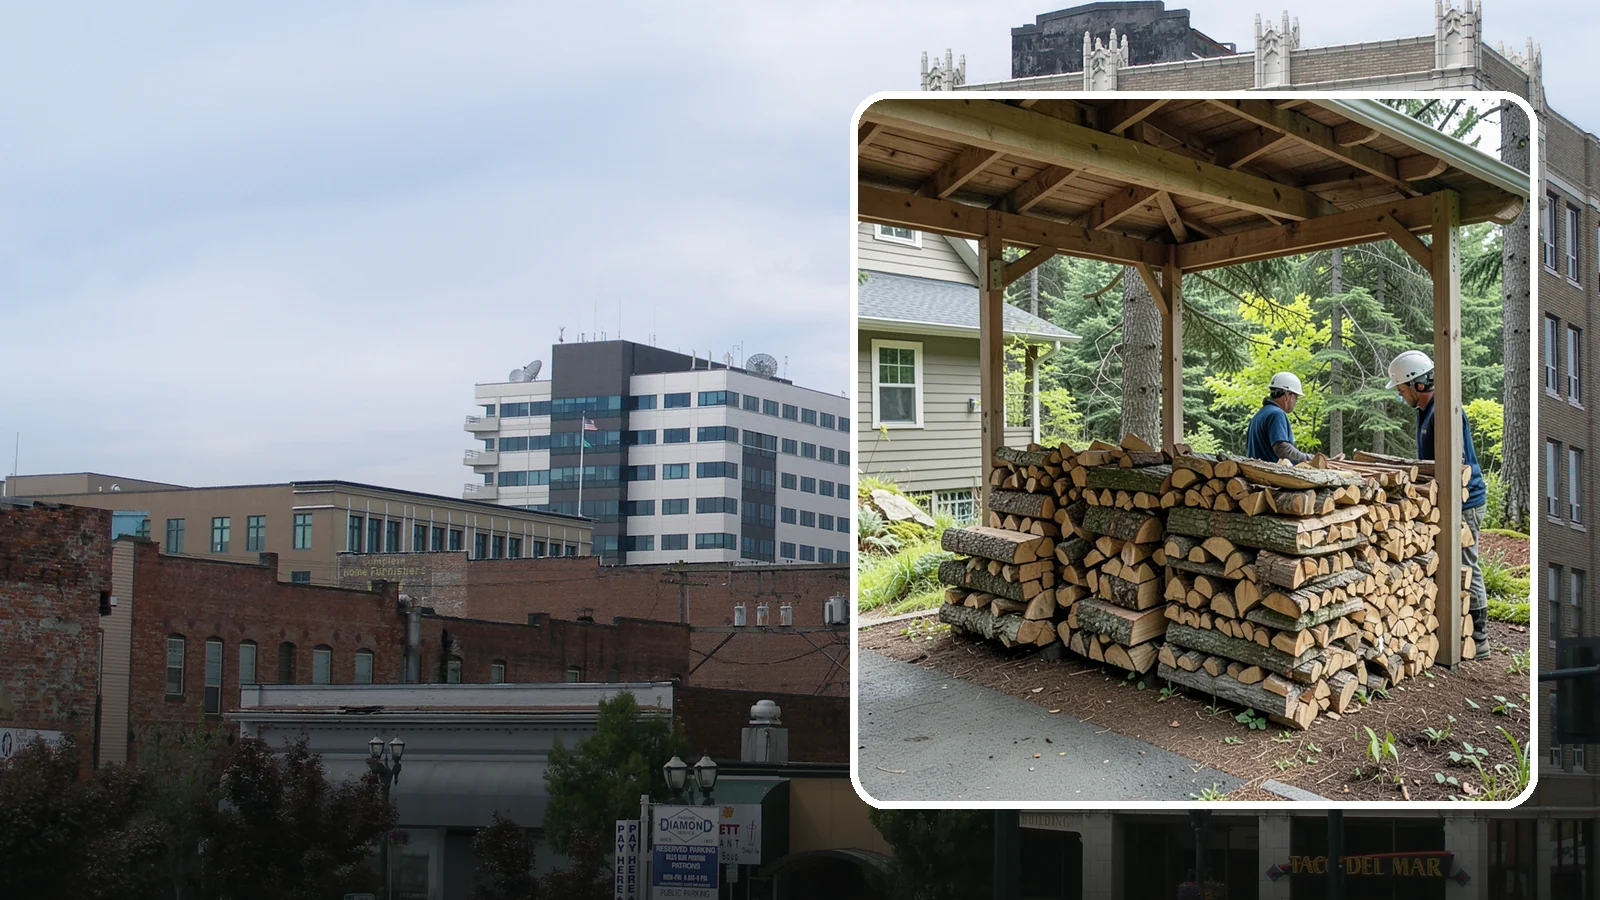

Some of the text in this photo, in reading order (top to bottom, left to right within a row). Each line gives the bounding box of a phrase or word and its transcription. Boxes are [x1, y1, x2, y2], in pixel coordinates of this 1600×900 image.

[343, 566, 427, 577] Home Furnishers
[660, 818, 713, 833] DIAMOND
[1022, 815, 1070, 828] BUILDING
[719, 824, 740, 835] ETT
[617, 824, 625, 852] PAY
[628, 824, 637, 852] PAY
[719, 839, 740, 849] ANT
[655, 845, 716, 854] RESERVED PARKING
[721, 851, 739, 862] Soup
[671, 862, 701, 870] PATRONS
[1346, 856, 1385, 876] DEL
[1392, 856, 1442, 877] MAR
[616, 855, 625, 893] HERE
[627, 855, 636, 893] HERE
[660, 888, 710, 898] PUBLIC PARKING
